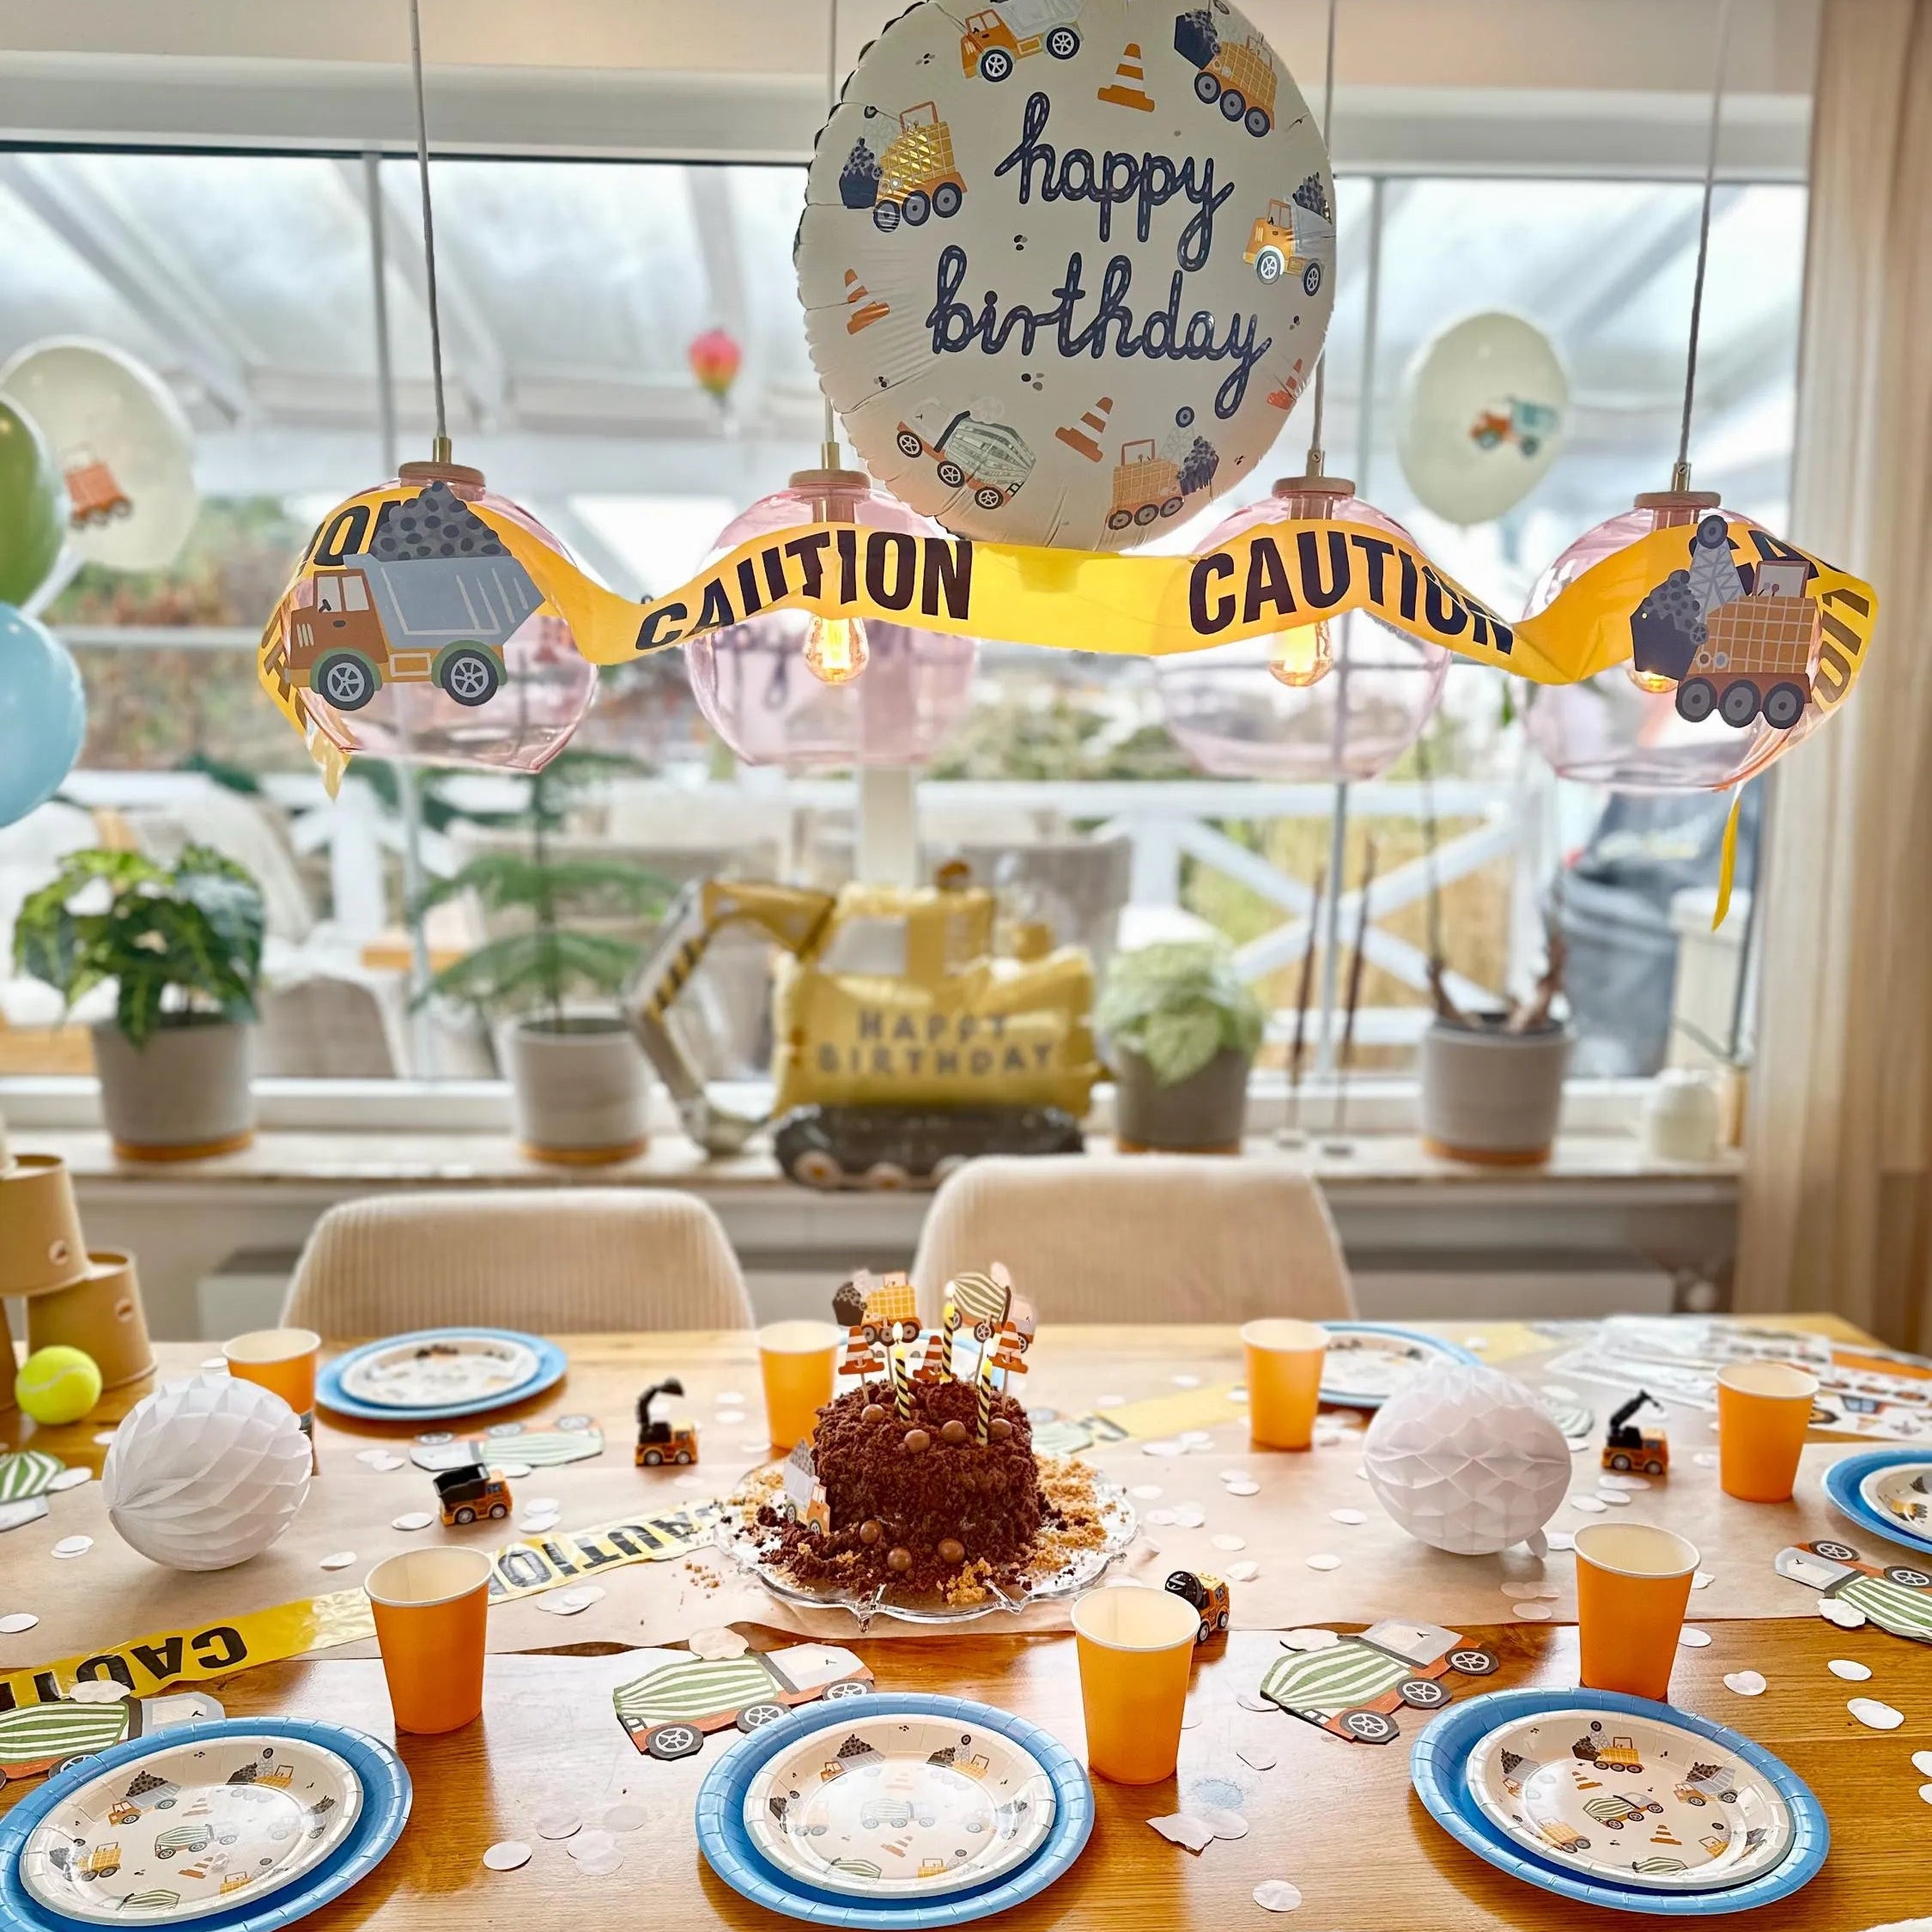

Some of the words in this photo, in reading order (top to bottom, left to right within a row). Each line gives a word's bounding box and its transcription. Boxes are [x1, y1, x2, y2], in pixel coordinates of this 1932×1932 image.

[993, 91, 1235, 271] happy
[927, 244, 1272, 419] birthday
[635, 530, 973, 650] CAUTION
[818, 1042, 1054, 1076] BIRTHDAY
